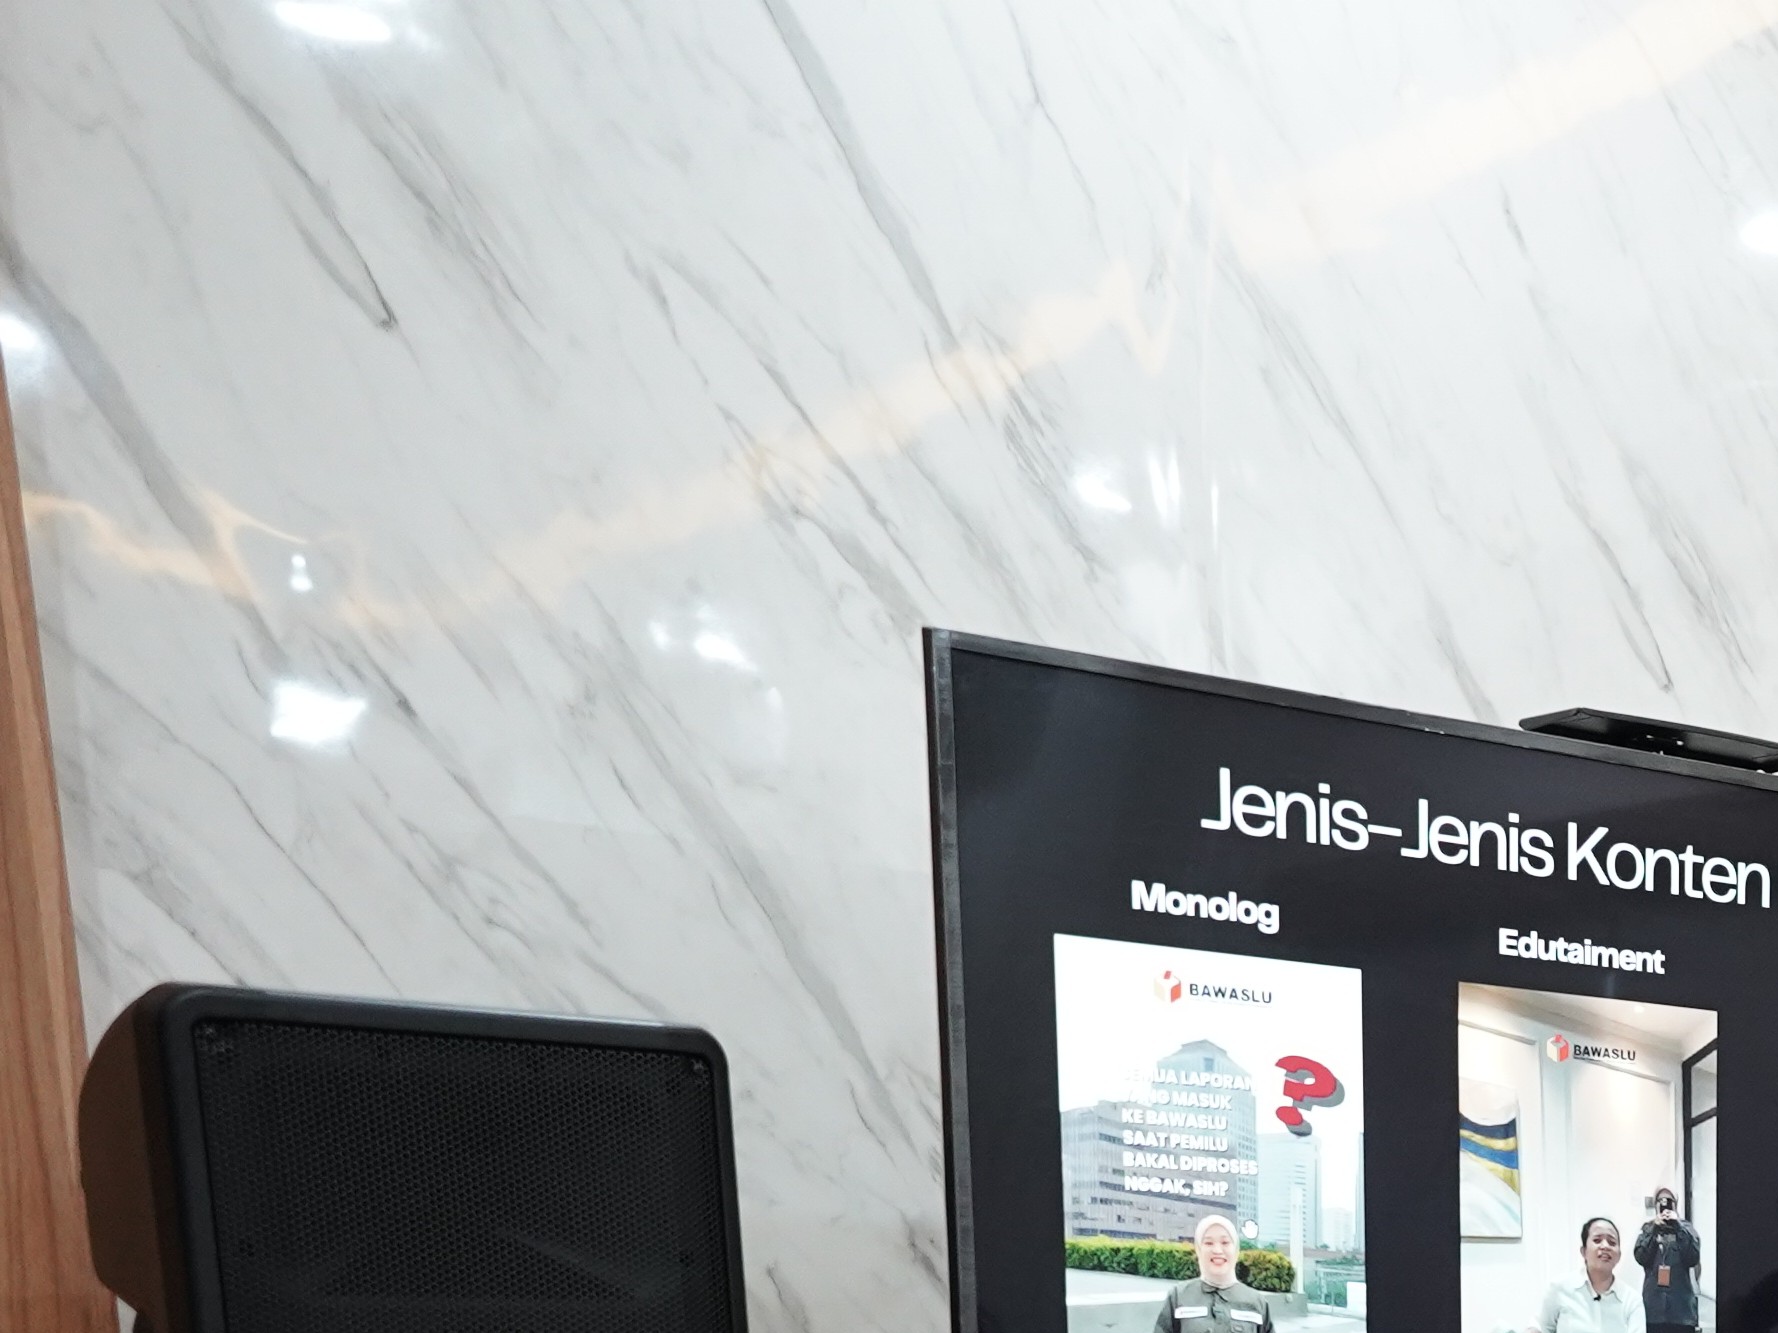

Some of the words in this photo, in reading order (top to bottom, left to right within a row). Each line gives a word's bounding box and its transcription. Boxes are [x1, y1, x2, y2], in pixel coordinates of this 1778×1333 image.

[1566, 826, 1771, 906] Konten
[1131, 879, 1280, 935] Monolog
[1498, 928, 1665, 975] Edutaiment
[1189, 983, 1272, 1003] BAWASLU
[1573, 1045, 1636, 1061] BAWASLU
[1174, 1091, 1232, 1110] MASUK
[1121, 1107, 1144, 1124] KE
[1147, 1109, 1227, 1131] BAWASLU
[1122, 1130, 1169, 1148] SAAT
[1170, 1133, 1229, 1152] PEMILU
[1122, 1151, 1178, 1170] BAKAL
[1181, 1156, 1258, 1176] DIPROSES
[1124, 1175, 1191, 1197] NGGAK,
[1193, 1179, 1229, 1197] SIH?
